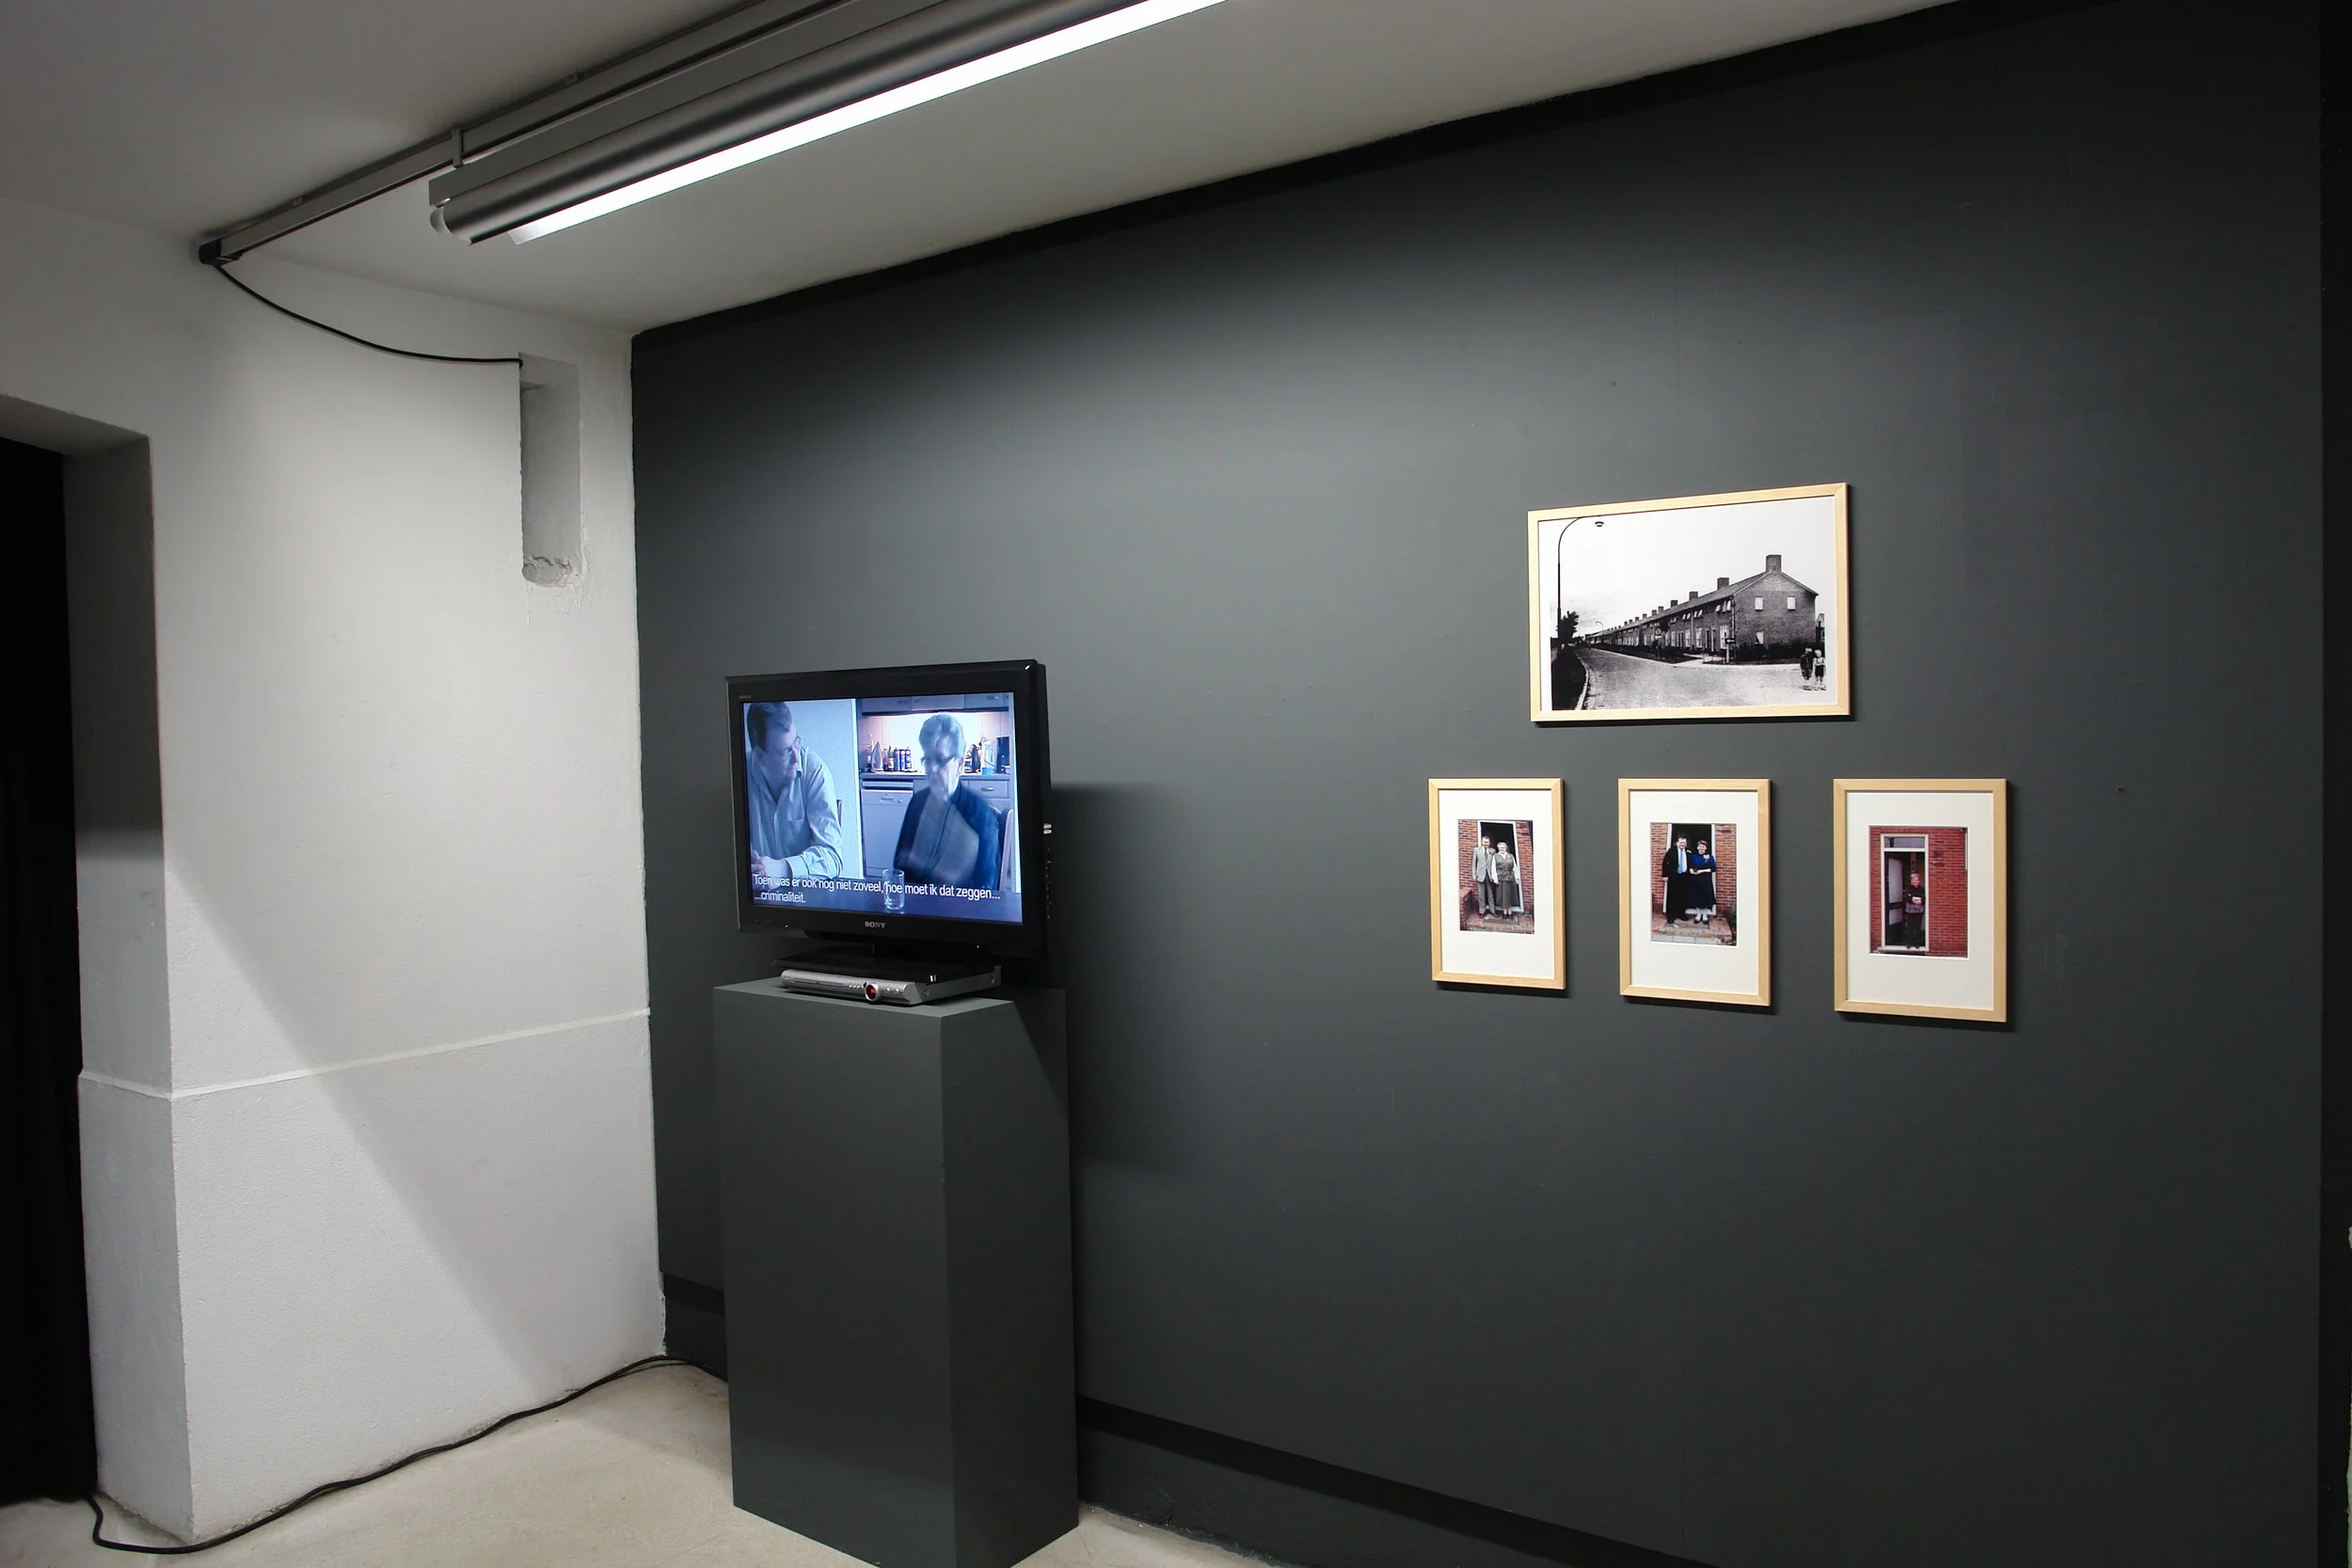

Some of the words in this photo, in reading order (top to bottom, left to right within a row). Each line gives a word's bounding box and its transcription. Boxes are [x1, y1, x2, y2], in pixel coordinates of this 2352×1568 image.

[754, 874, 773, 885] Toen
[773, 878, 790, 887] was
[792, 879, 800, 887] er
[803, 878, 818, 889] ook
[818, 879, 834, 892] nog
[836, 879, 851, 891] niet
[853, 881, 883, 895] zoveel,
[886, 881, 903, 894] hoe
[905, 884, 928, 895] moet
[930, 883, 938, 895] ik
[940, 884, 955, 896] dat
[957, 887, 1001, 900] zeggen...
[865, 920, 886, 929] SONY
